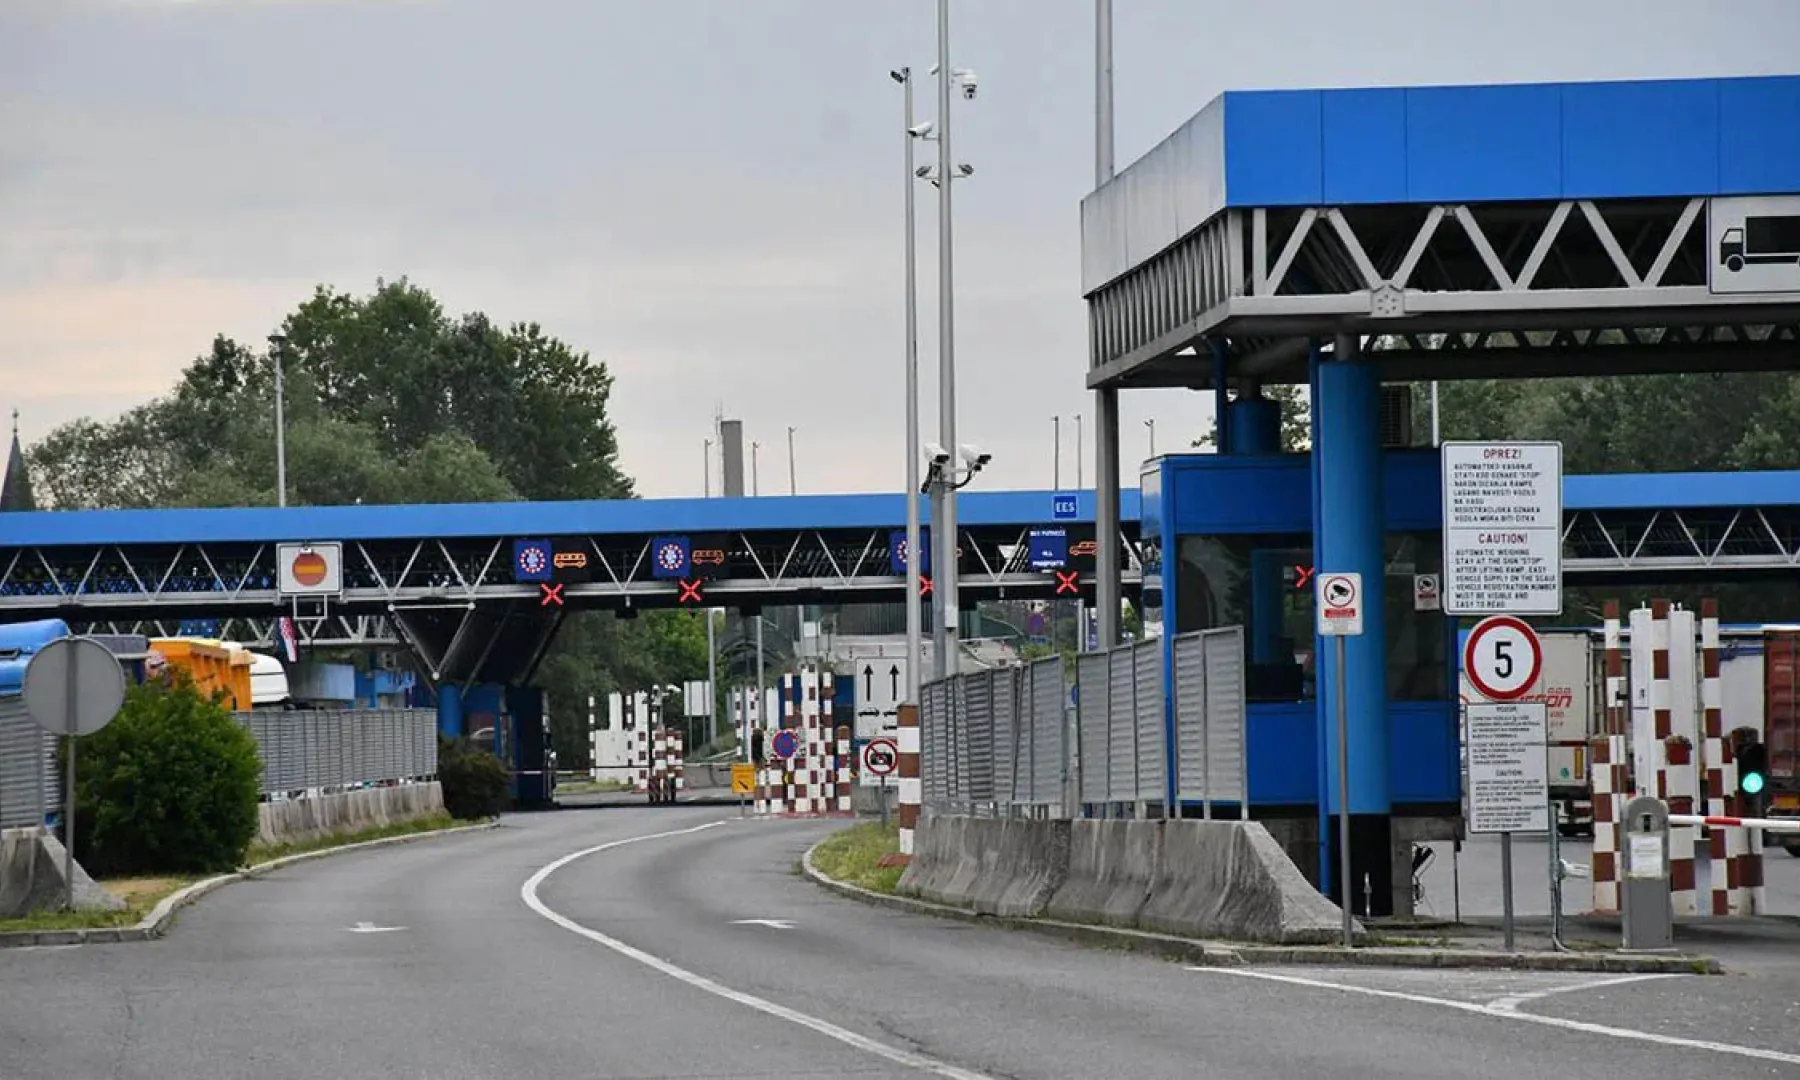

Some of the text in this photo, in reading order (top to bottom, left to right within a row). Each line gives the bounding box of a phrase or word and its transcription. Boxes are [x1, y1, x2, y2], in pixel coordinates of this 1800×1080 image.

[1483, 449, 1521, 460] OPREZ!
[1056, 502, 1075, 513] EES
[1478, 533, 1528, 545] CAUTION!
[1476, 557, 1486, 565] AT
[1488, 557, 1501, 565] THE
[1456, 566, 1477, 574] AFTER
[1456, 583, 1482, 591] VEHICLE
[1483, 583, 1530, 591] REGISTRATION
[1456, 592, 1529, 600] MUST BE VISIBLE AND
[1456, 600, 1506, 609] EASY TO READ
[1494, 641, 1513, 678] 5
